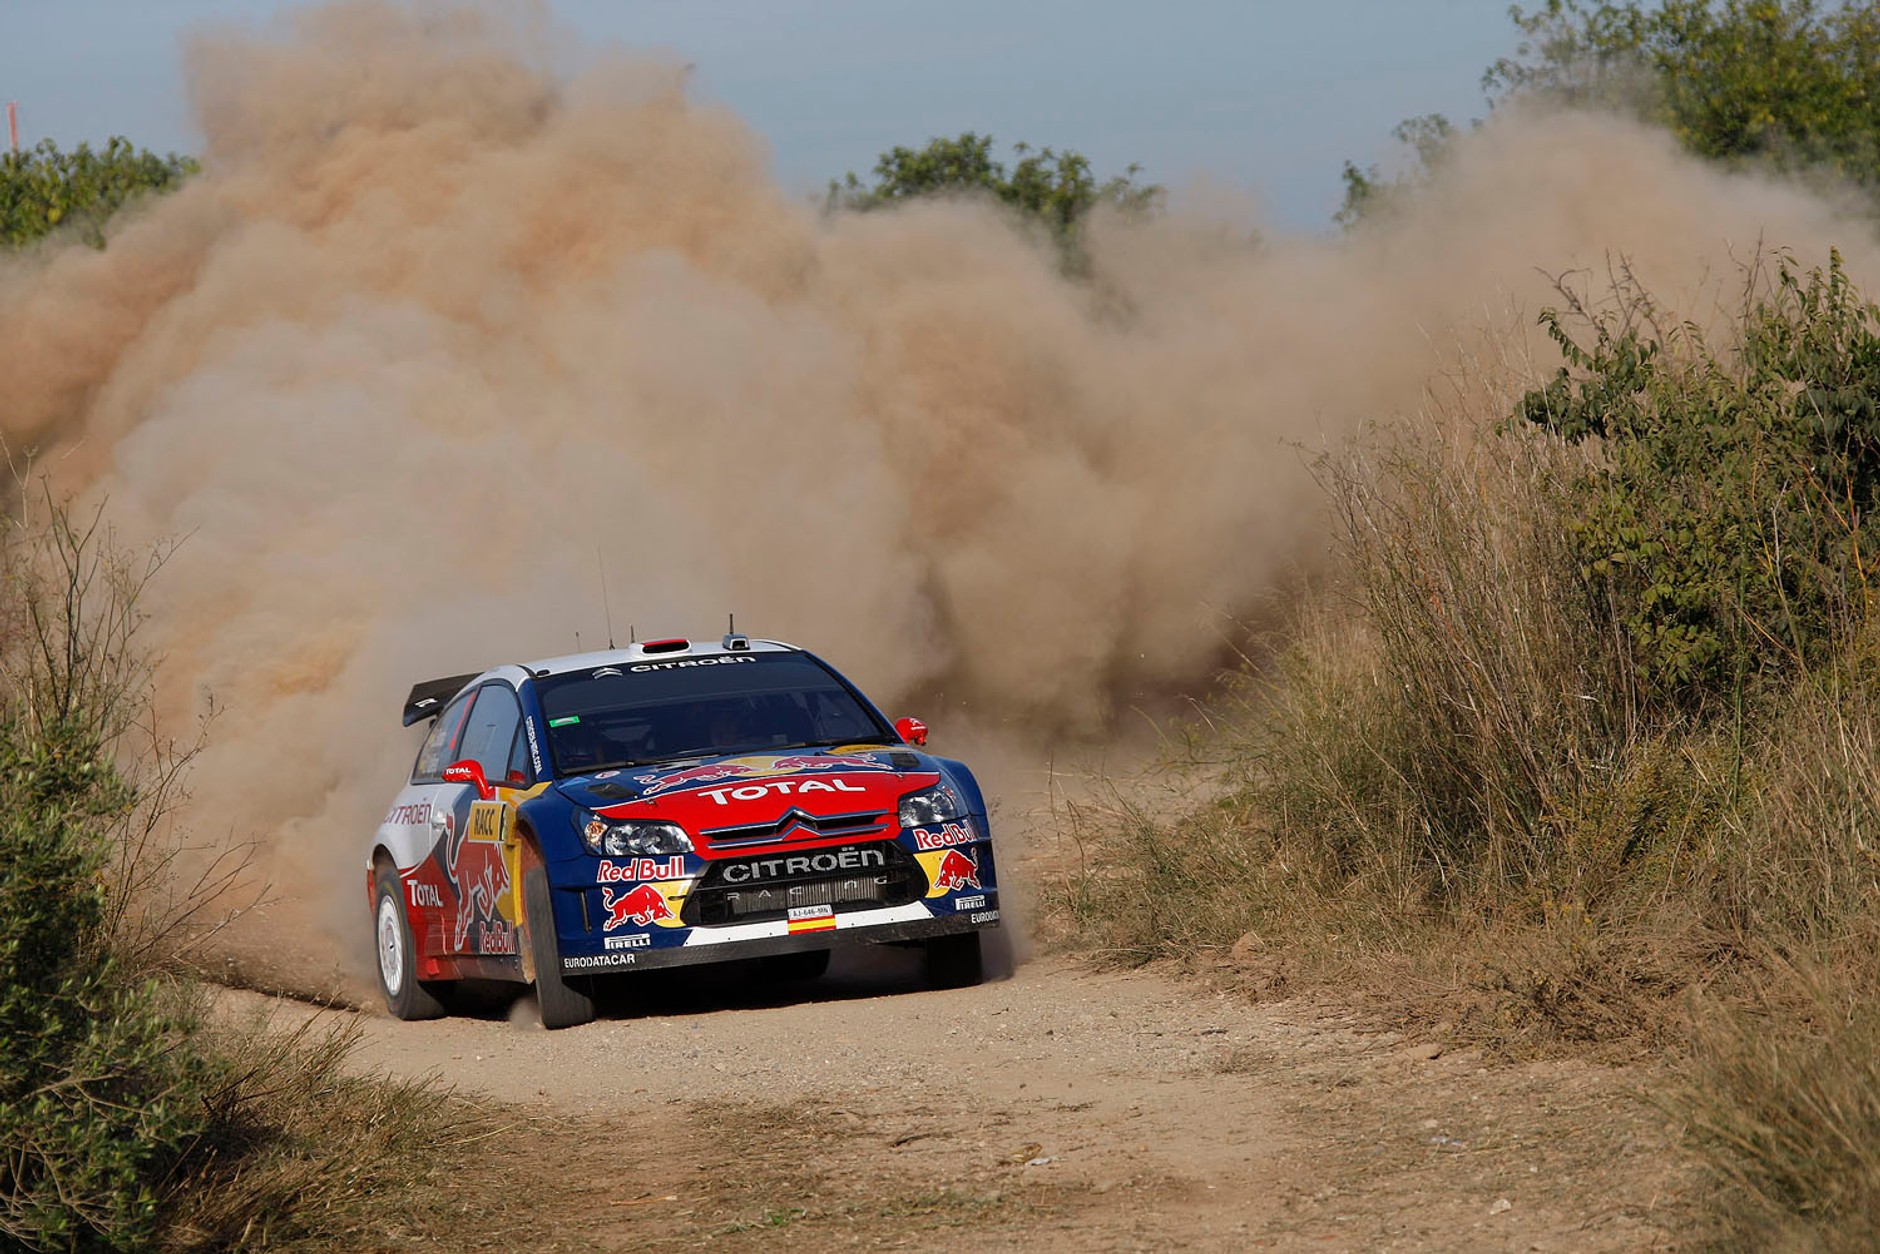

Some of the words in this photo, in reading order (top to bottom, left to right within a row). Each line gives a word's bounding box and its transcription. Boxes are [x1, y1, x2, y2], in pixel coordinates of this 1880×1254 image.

[630, 655, 757, 673] CITROËN
[445, 767, 472, 775] TOTAL
[697, 779, 867, 806] TOTAL
[473, 807, 496, 837] RACC
[912, 823, 956, 851] Red
[597, 858, 637, 883] Red
[638, 855, 685, 881] Bull
[723, 847, 884, 882] CITROËN
[956, 895, 985, 911] PIRELLI
[480, 920, 496, 954] Red
[604, 933, 651, 950] PIRELLI
[564, 953, 636, 969] EURODATACAR
